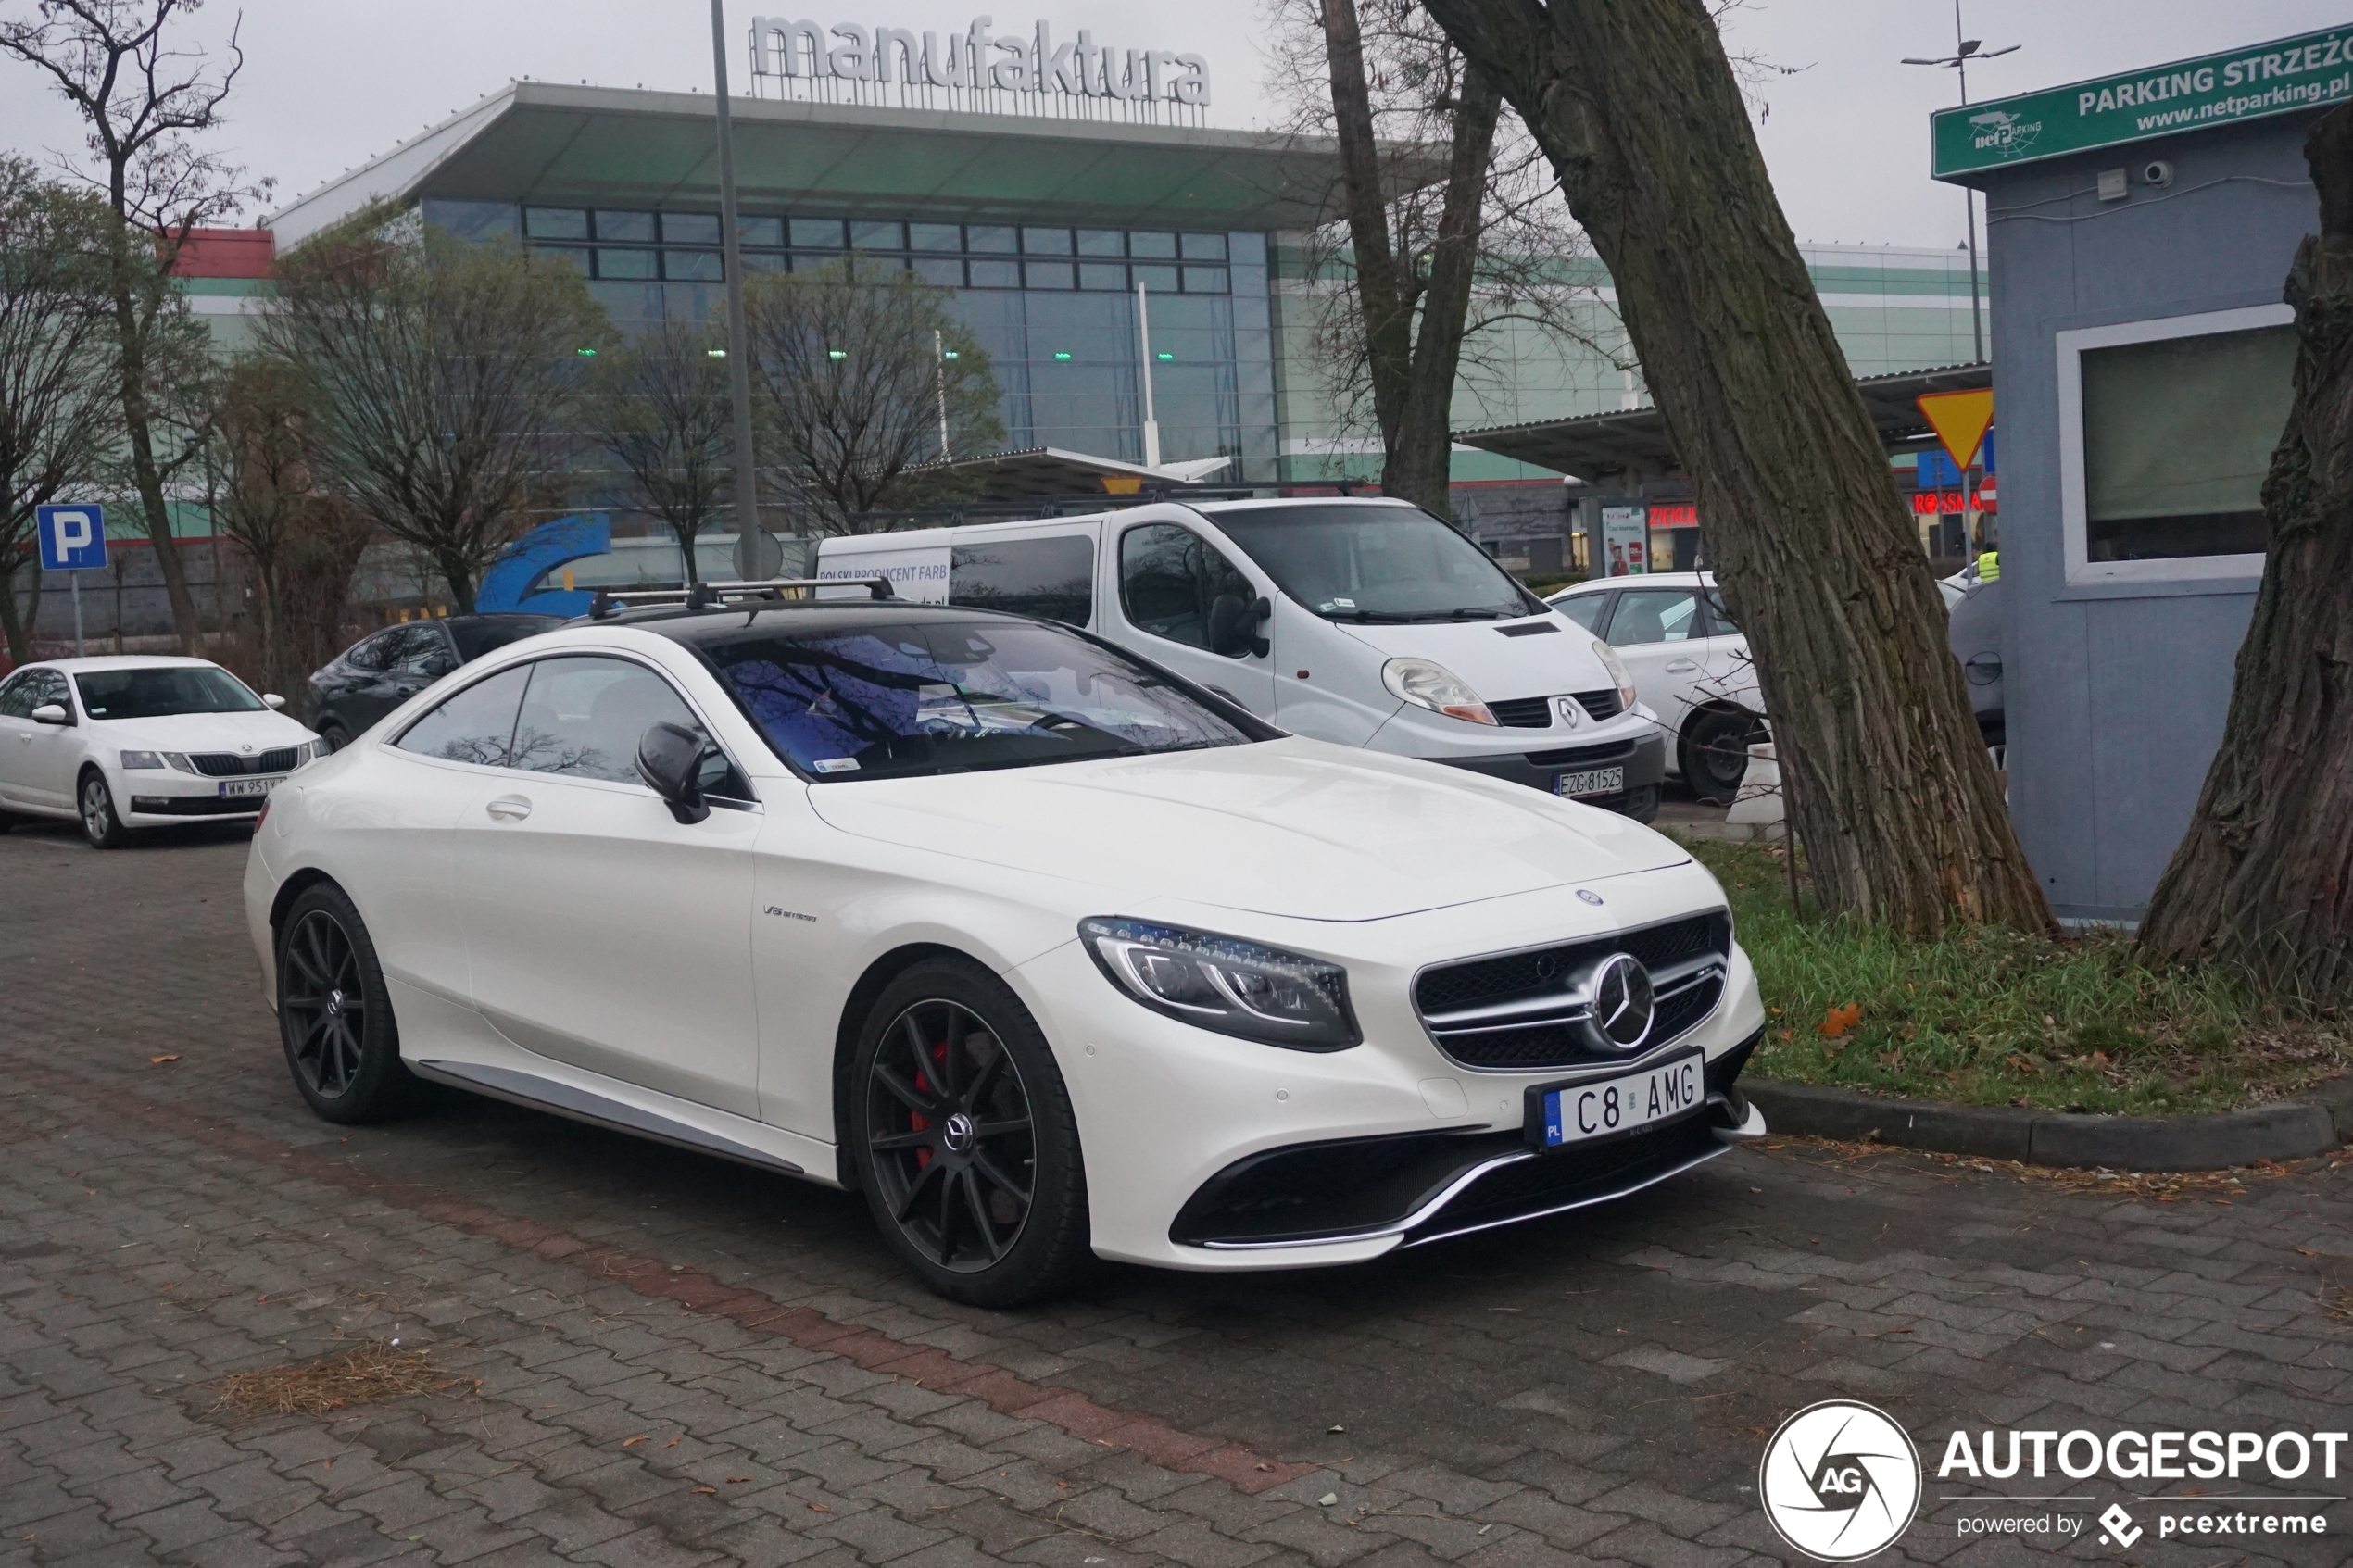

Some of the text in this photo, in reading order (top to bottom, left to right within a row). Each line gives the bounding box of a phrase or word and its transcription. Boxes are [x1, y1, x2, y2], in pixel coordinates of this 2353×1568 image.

[751, 15, 1211, 106] manufaktura
[2079, 68, 2214, 116] PARKING
[2137, 71, 2349, 131] www.netparking.pl
[1914, 492, 1984, 514] ROSSMA
[53, 511, 92, 562] P
[919, 565, 947, 580] FARB
[228, 779, 283, 795] WW 951Y
[1561, 769, 1621, 794] EZG 81525
[1578, 1064, 1694, 1134] C8 AMG
[1548, 1125, 1561, 1138] PL
